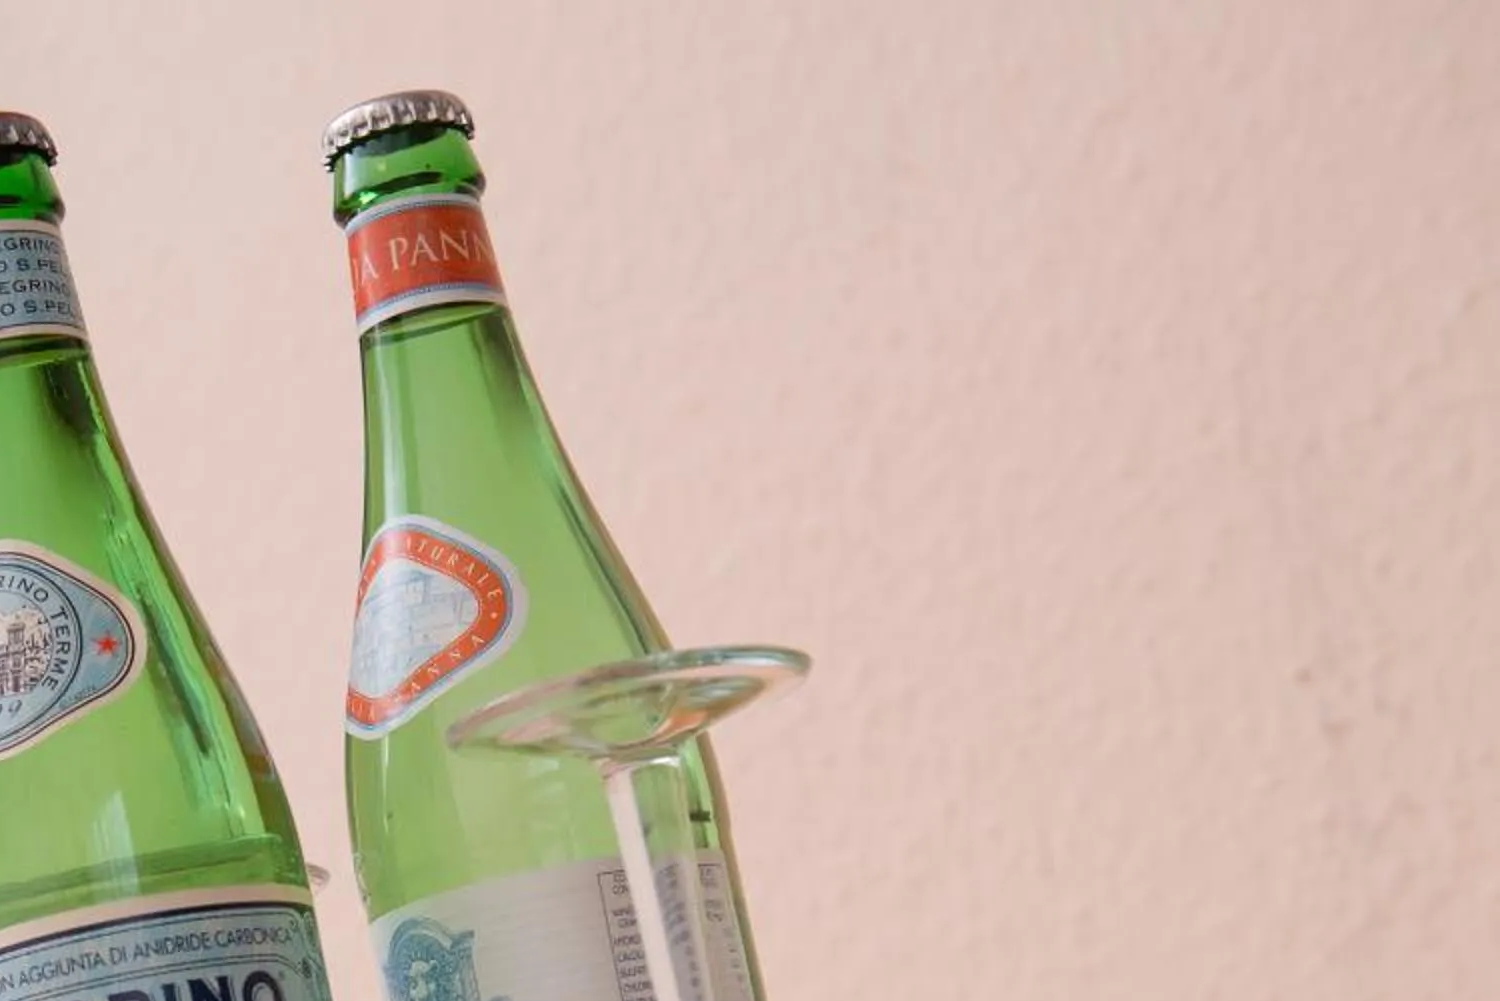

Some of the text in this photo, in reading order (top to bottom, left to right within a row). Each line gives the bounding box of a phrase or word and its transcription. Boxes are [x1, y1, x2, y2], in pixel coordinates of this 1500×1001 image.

[42, 605, 71, 691] TERME
[18, 952, 106, 985] AGGIUNTA
[110, 946, 129, 965] DI
[132, 932, 210, 960] ANIDRIDE
